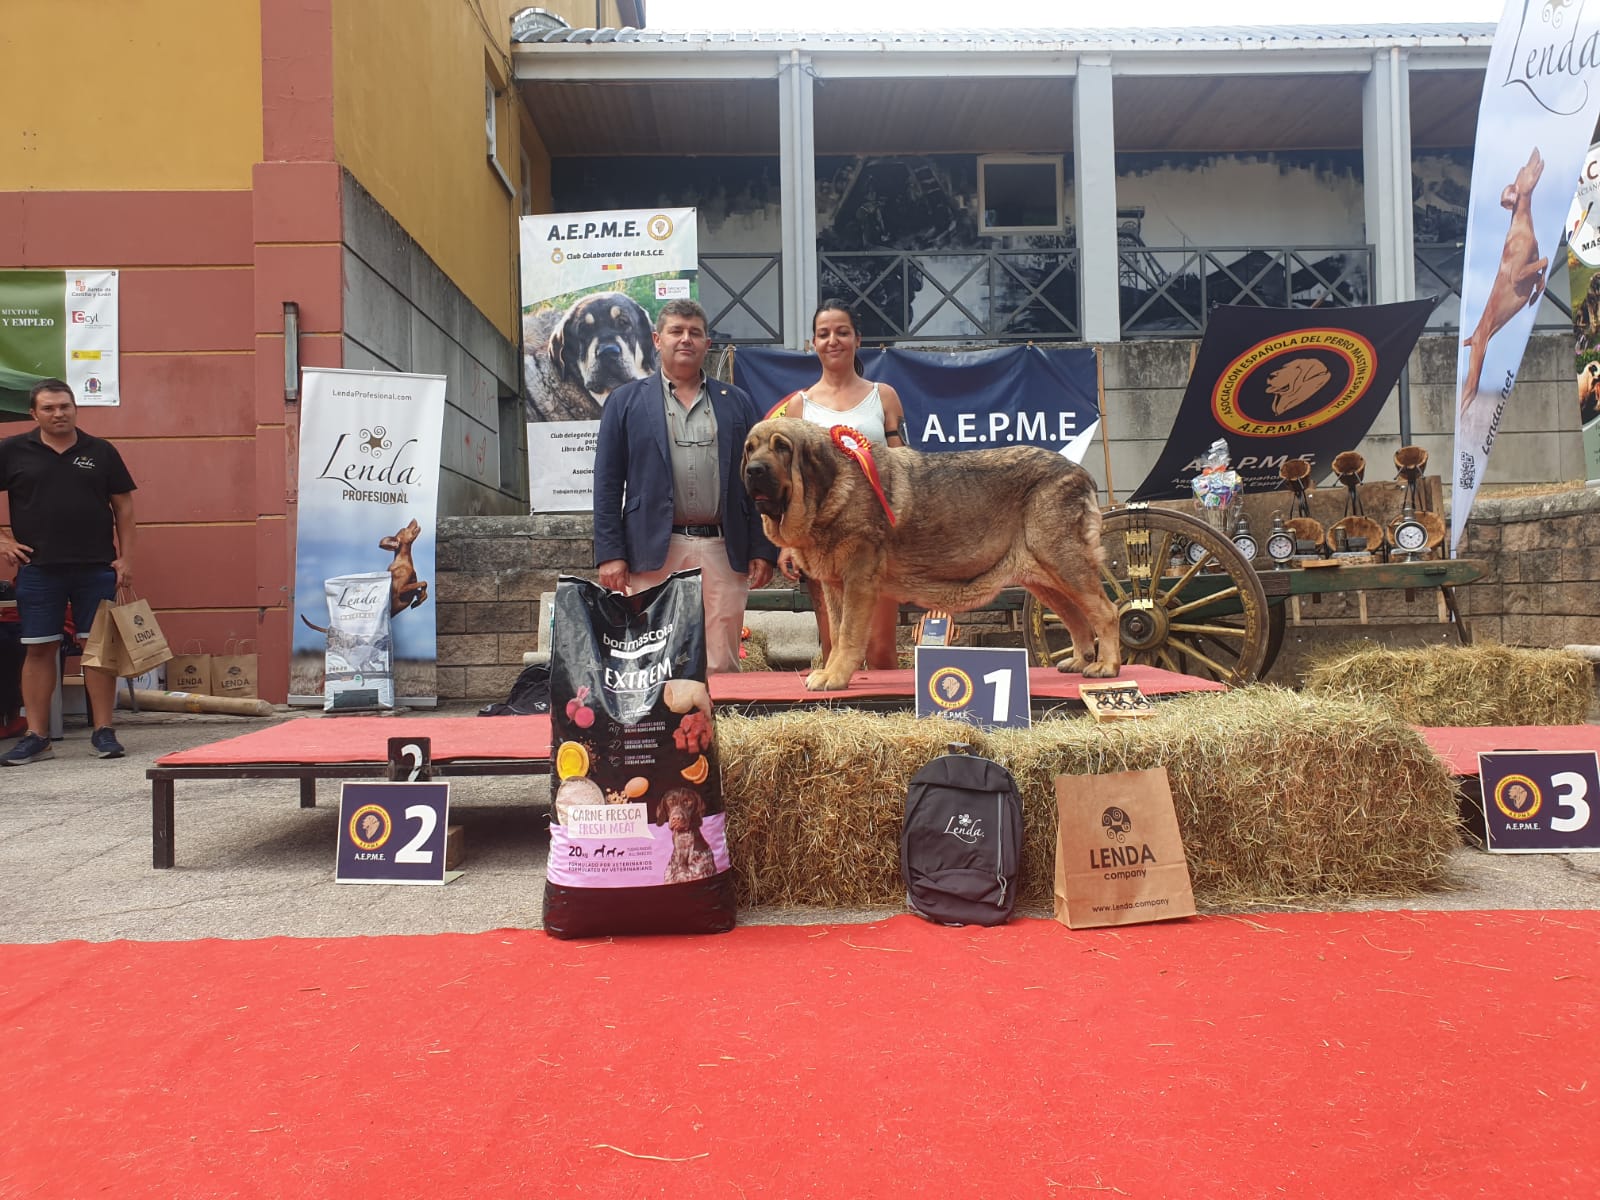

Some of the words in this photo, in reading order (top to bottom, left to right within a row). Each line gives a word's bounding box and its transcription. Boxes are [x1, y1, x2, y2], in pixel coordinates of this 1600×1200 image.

[1502, 0, 1600, 115] Lenda
[548, 221, 640, 241] A.E.P.M.E.
[582, 251, 622, 259] Colaborador
[2, 318, 10, 326] Y
[12, 318, 54, 327] EMPLEO
[1301, 336, 1322, 344] DEL
[1324, 336, 1355, 350] PERRO
[1240, 338, 1298, 370] ESPAÑOLA
[1352, 347, 1368, 377] MASTÍN
[332, 389, 412, 400] LendaProfesional.com
[1220, 368, 1244, 416] ASOCIACIÓN
[1332, 376, 1365, 413] ESPAÑOL
[1482, 369, 1515, 456] Lenda.net
[1238, 420, 1312, 434] A.E.P.M.E.
[315, 433, 422, 490] Lenda
[342, 489, 409, 504] PROFESIONAL
[338, 586, 378, 611] Lenda
[134, 628, 156, 644] LENDA
[603, 623, 674, 650] bonmascota
[178, 678, 203, 686] LENDA
[605, 657, 673, 689] EXTREM
[221, 679, 250, 688] LENDA
[983, 669, 1012, 722] 1
[1550, 772, 1590, 832] 3
[572, 809, 603, 821] CARNE
[606, 808, 642, 820] FRESCA
[394, 804, 437, 864] 2
[578, 823, 606, 834] FRESH
[608, 822, 635, 834] MEAT
[944, 814, 984, 844] Lenda
[1506, 823, 1541, 831] A.E.P.M.E.
[354, 852, 386, 861] A.E.P.M.E.
[1090, 844, 1157, 870] LENDA
[1104, 868, 1147, 881] company
[1092, 898, 1170, 913] www.Lenda.company
